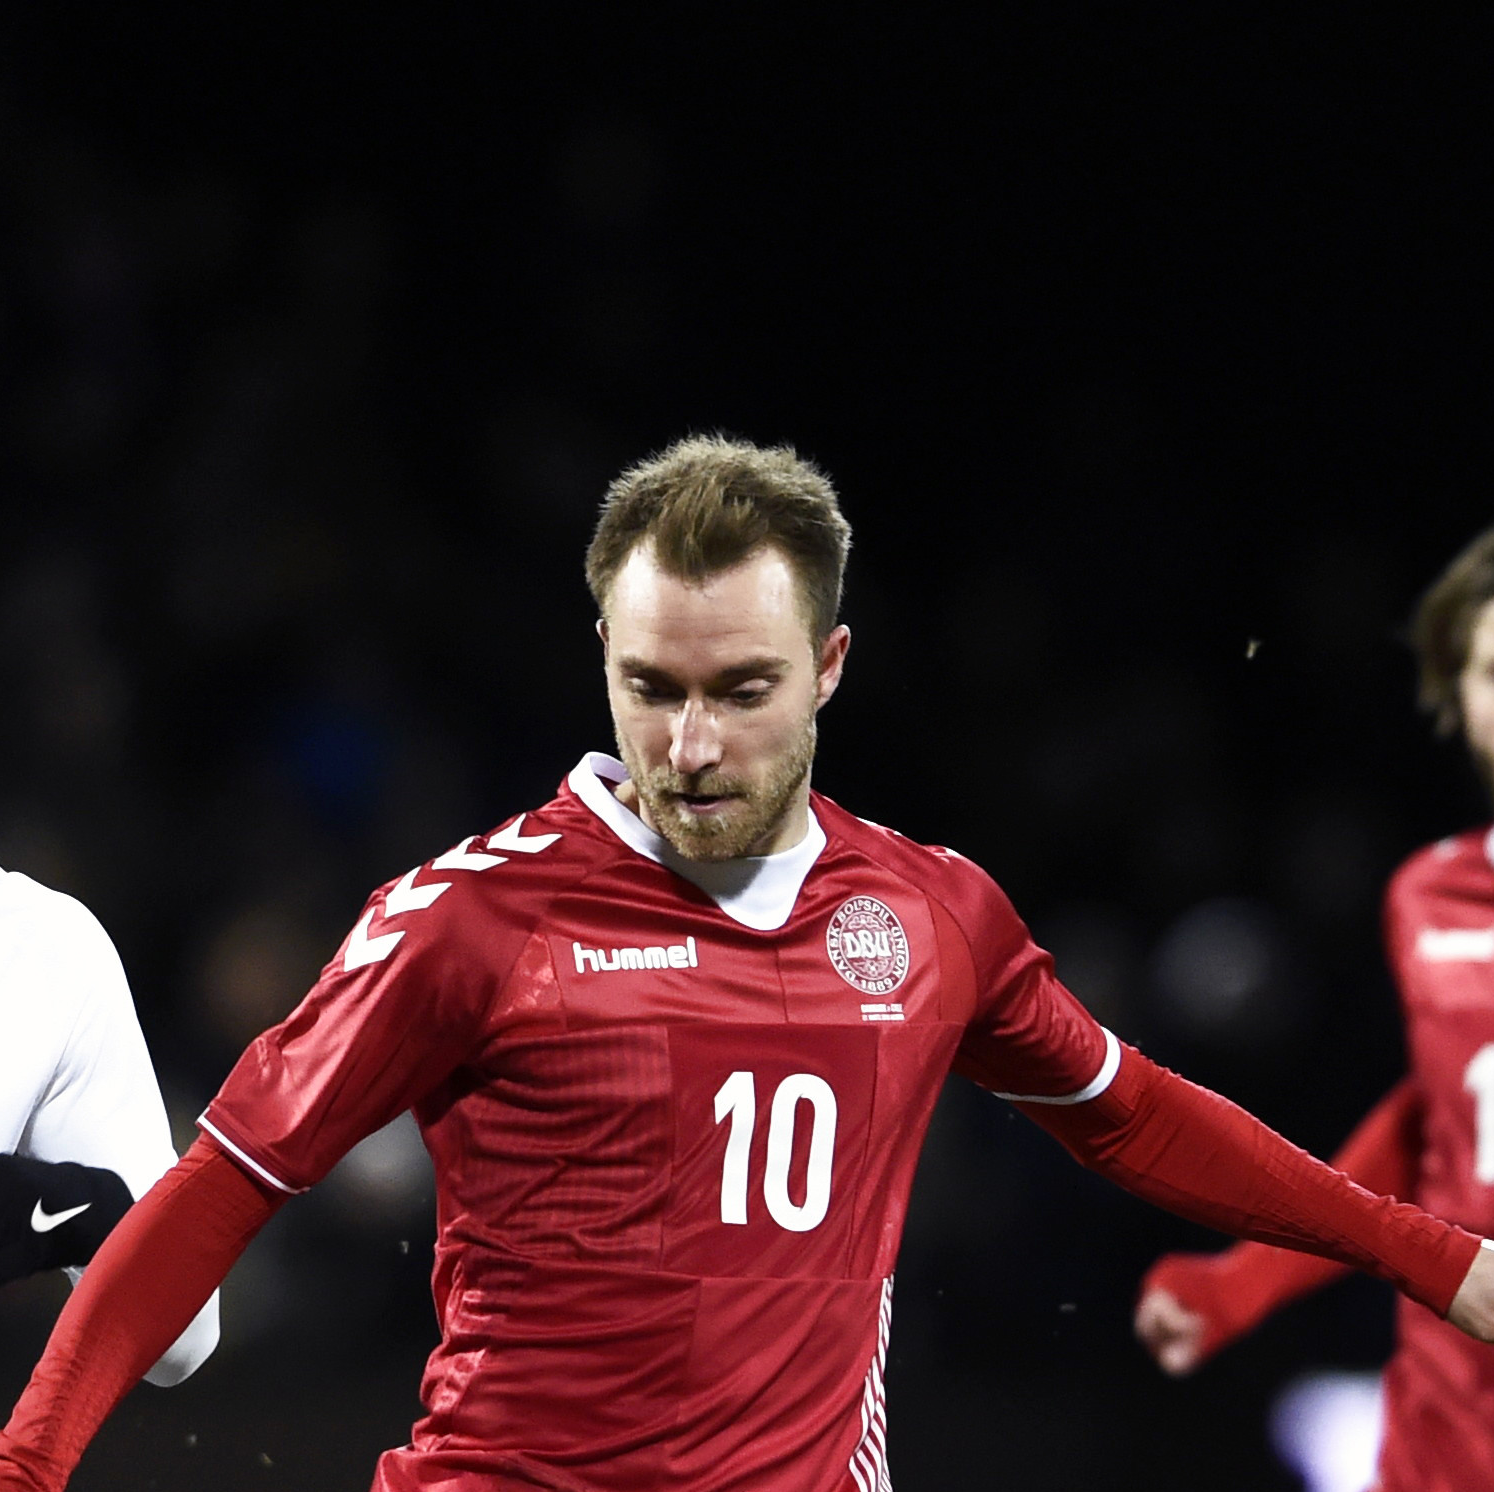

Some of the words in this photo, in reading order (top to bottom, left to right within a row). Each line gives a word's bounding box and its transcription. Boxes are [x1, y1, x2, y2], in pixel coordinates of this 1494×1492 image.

[572, 935, 698, 974] hummel
[842, 929, 892, 959] DBU
[713, 1071, 838, 1233] 10
